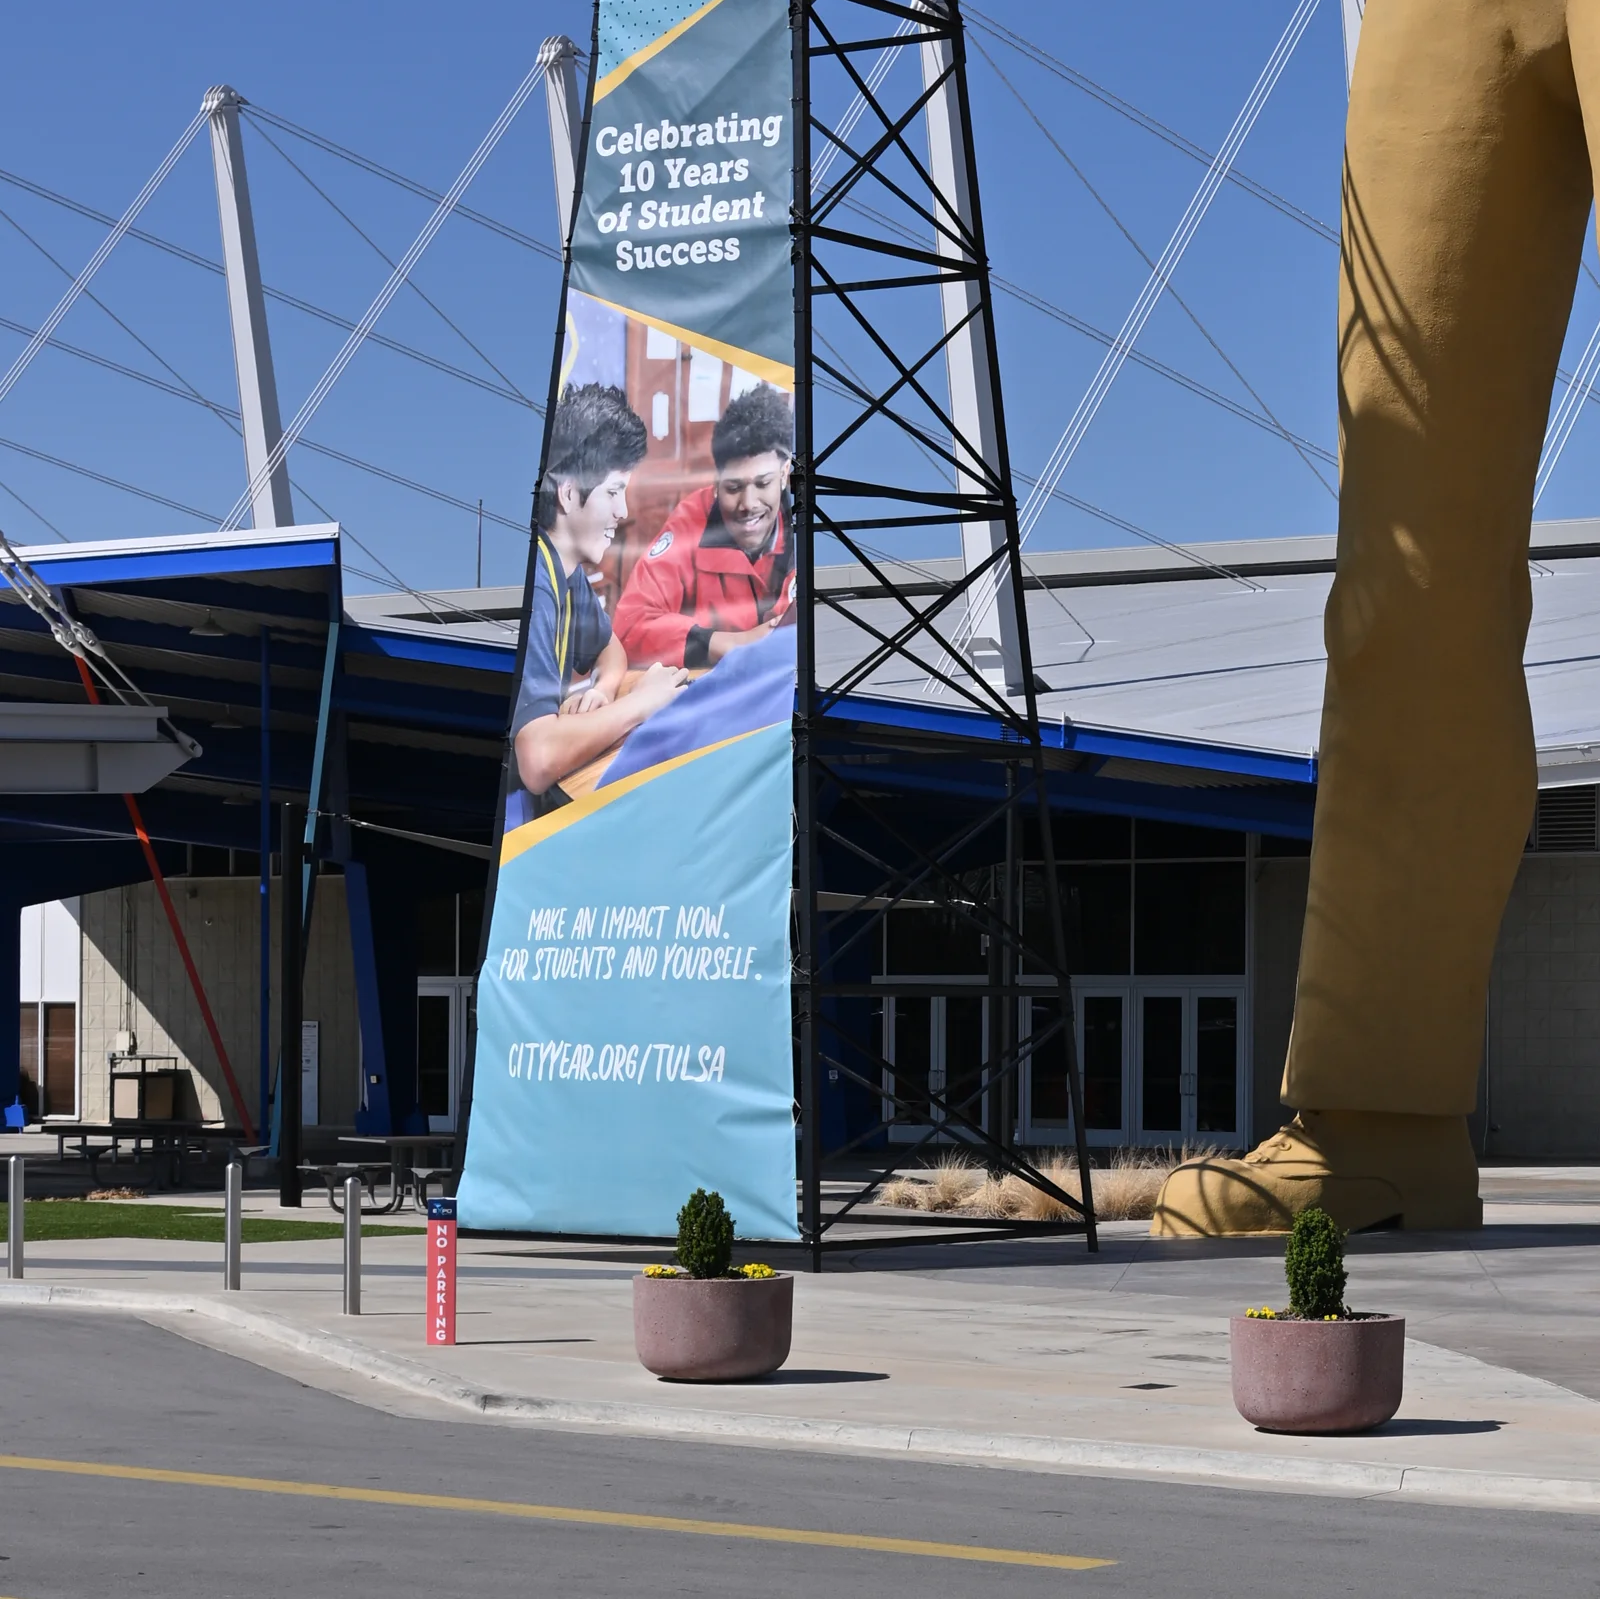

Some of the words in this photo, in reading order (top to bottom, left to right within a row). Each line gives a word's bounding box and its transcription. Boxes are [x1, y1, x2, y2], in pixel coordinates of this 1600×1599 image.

[595, 112, 783, 157] Celebrating
[619, 160, 655, 193] 10
[664, 157, 749, 189] Years
[597, 202, 632, 234] of
[637, 191, 765, 230] Student
[615, 237, 740, 272] Success
[527, 908, 567, 941] MAKE
[571, 907, 597, 940] AN
[600, 905, 670, 940] IMPACT
[675, 904, 730, 940] NOW.
[500, 948, 528, 981] FOR
[532, 946, 616, 981] STUDENTS
[620, 945, 658, 980] AND
[661, 943, 763, 981] YOURSELF.
[508, 1040, 726, 1085] CITYYEAR.ORG/TULSA
[436, 1225, 448, 1248] NO
[436, 1256, 446, 1341] PARKING
